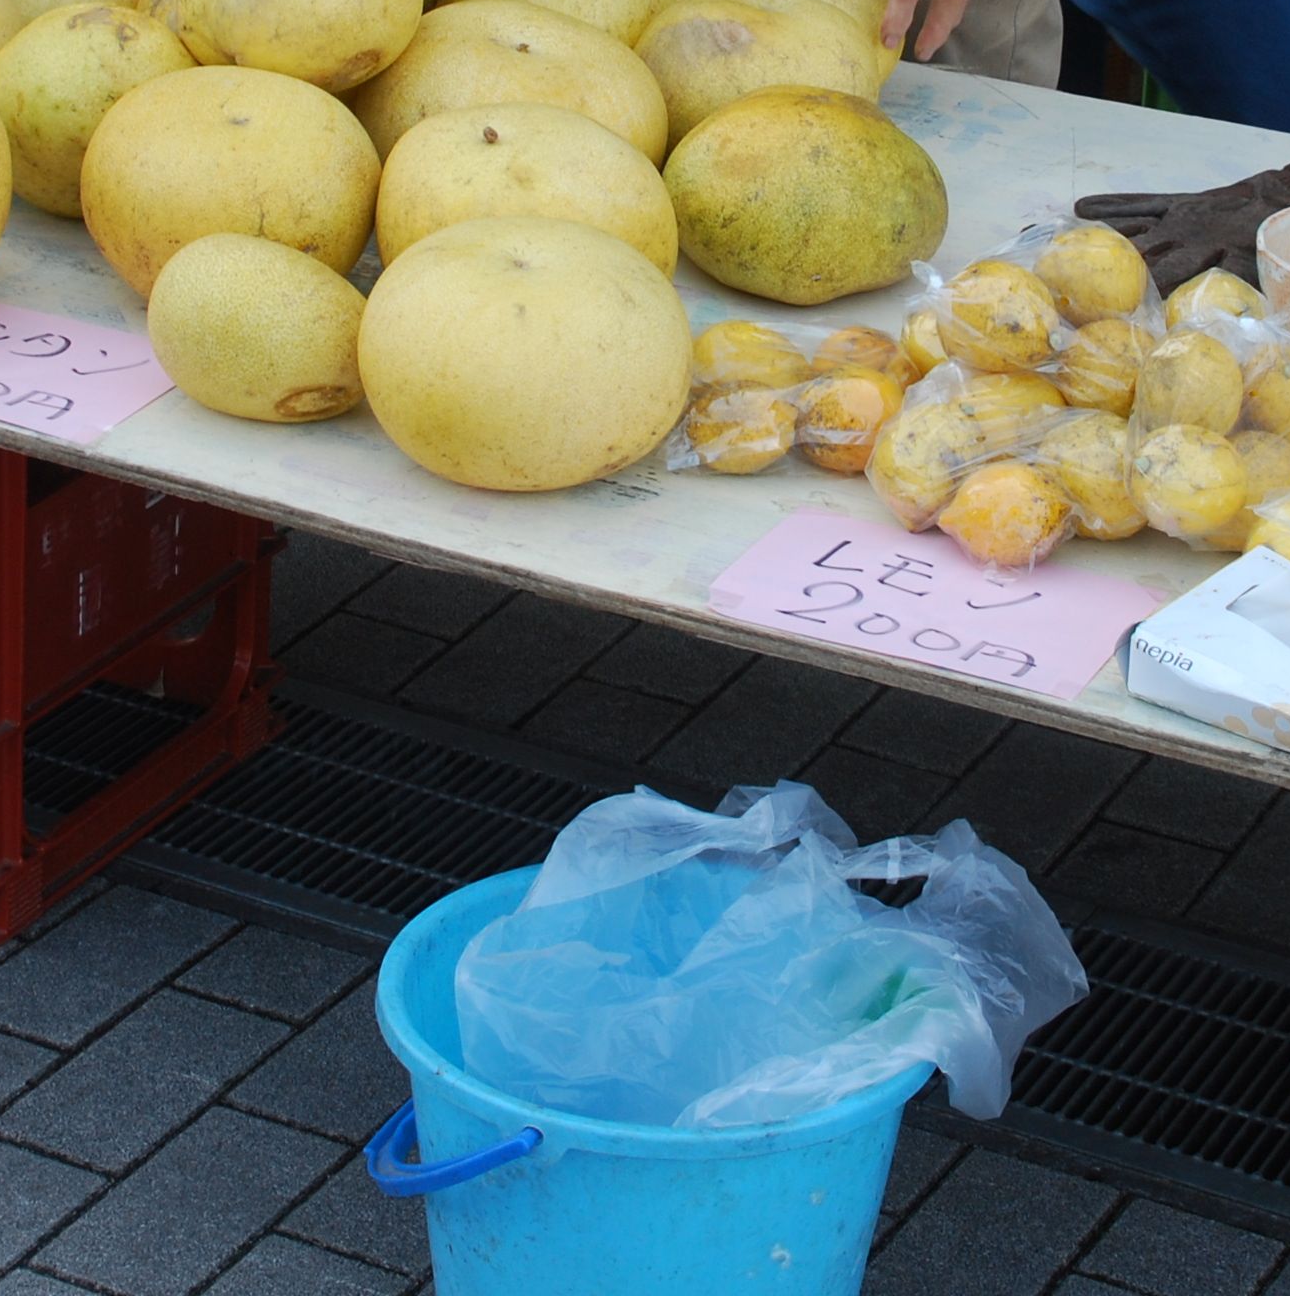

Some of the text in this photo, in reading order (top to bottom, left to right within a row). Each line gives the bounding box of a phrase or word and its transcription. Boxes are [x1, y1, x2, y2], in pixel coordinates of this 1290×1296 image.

[812, 540, 1042, 610] レモン
[775, 580, 1038, 678] 200円
[1135, 638, 1194, 672] nepia
